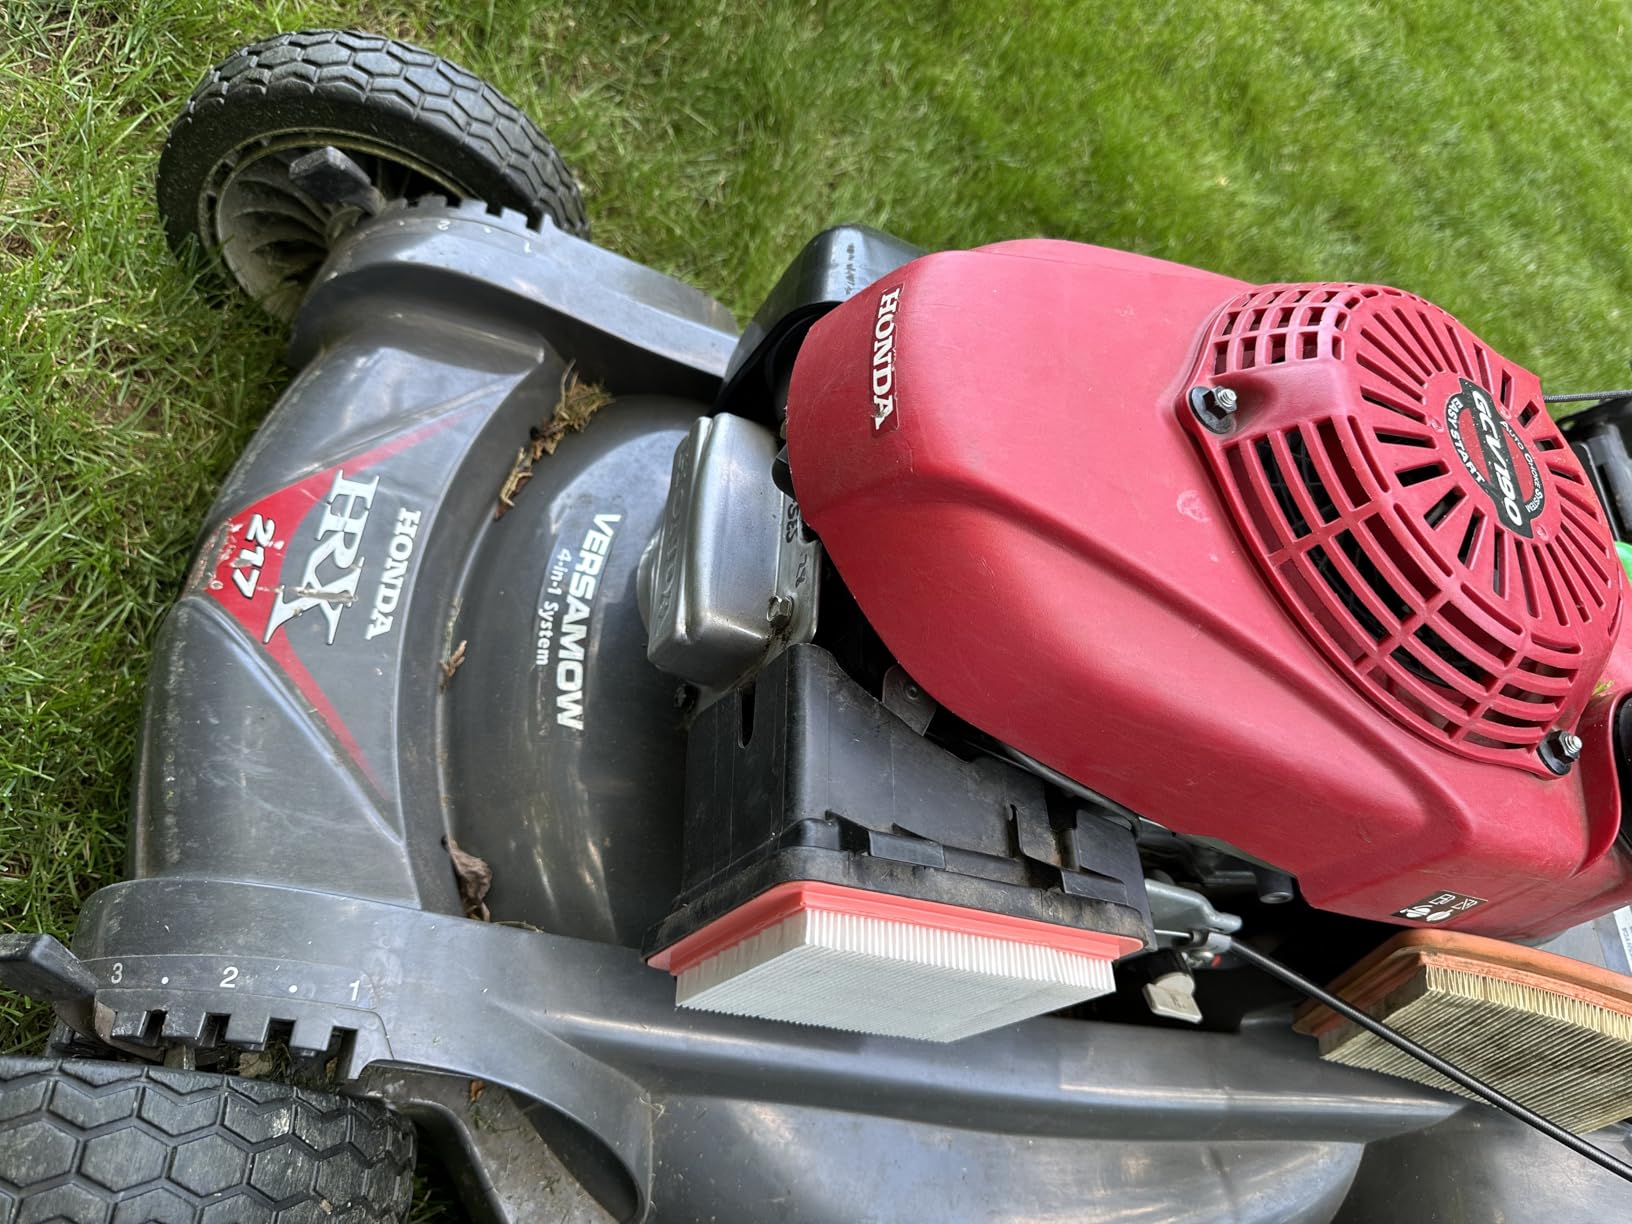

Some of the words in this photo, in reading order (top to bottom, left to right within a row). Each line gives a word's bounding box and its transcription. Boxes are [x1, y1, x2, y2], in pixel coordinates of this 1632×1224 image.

[437, 219, 450, 231] 2
[872, 287, 900, 431] HONDA
[1447, 397, 1464, 428] EASY
[1450, 428, 1486, 484] START
[1472, 390, 1523, 526] GCV190
[1500, 420, 1525, 450] AUTO
[1524, 453, 1542, 489] CHOKE
[232, 513, 276, 598] 217
[263, 469, 380, 645] HRX
[365, 507, 422, 641] HONDA
[547, 548, 573, 596] 4-in-1
[535, 601, 560, 666] System
[556, 513, 622, 731] VERSAMOW
[110, 962, 124, 984] 3
[219, 966, 239, 989] 2
[349, 979, 361, 1002] 1
